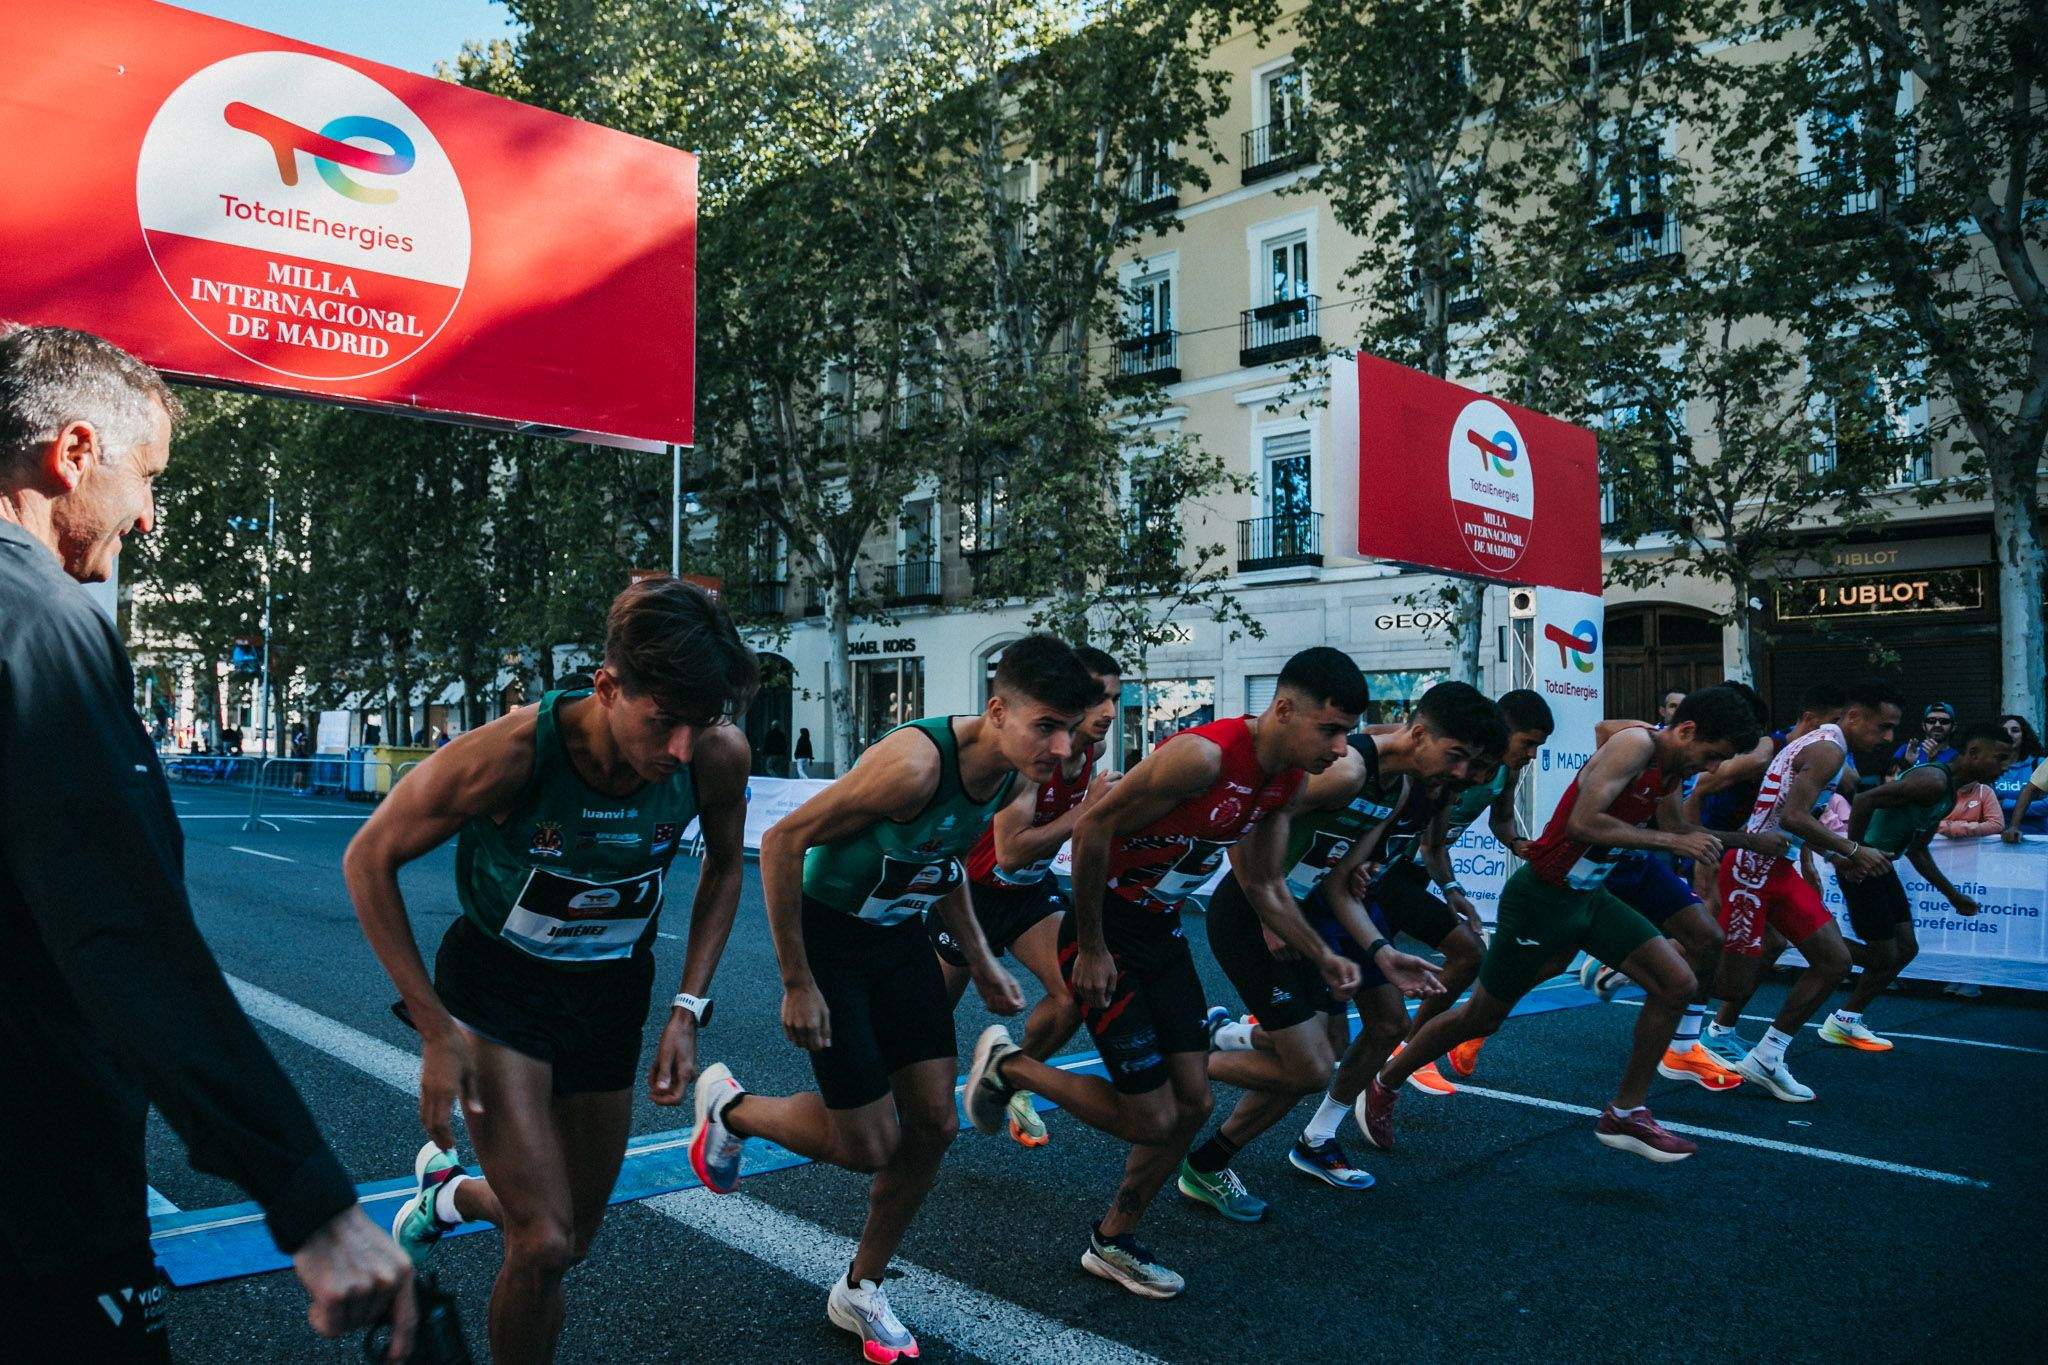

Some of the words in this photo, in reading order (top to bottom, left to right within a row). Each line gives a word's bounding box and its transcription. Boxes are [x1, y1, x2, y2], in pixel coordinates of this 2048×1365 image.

[219, 194, 414, 253] TotalEnergies
[266, 262, 360, 298] MILLA
[227, 313, 270, 341] DE
[276, 321, 390, 359] MADRID
[1469, 478, 1520, 503] TotalEnergies
[1483, 512, 1507, 528] MILLA
[1474, 540, 1486, 553] DE
[1486, 543, 1516, 559] MADRID
[1375, 611, 1453, 631] GEOX
[883, 638, 916, 653] KORS
[1545, 680, 1598, 701] TotalEnergies
[1919, 900, 1950, 913] que
[547, 925, 608, 937] JIMÉNEZ
[1913, 917, 1998, 934] preferidas
